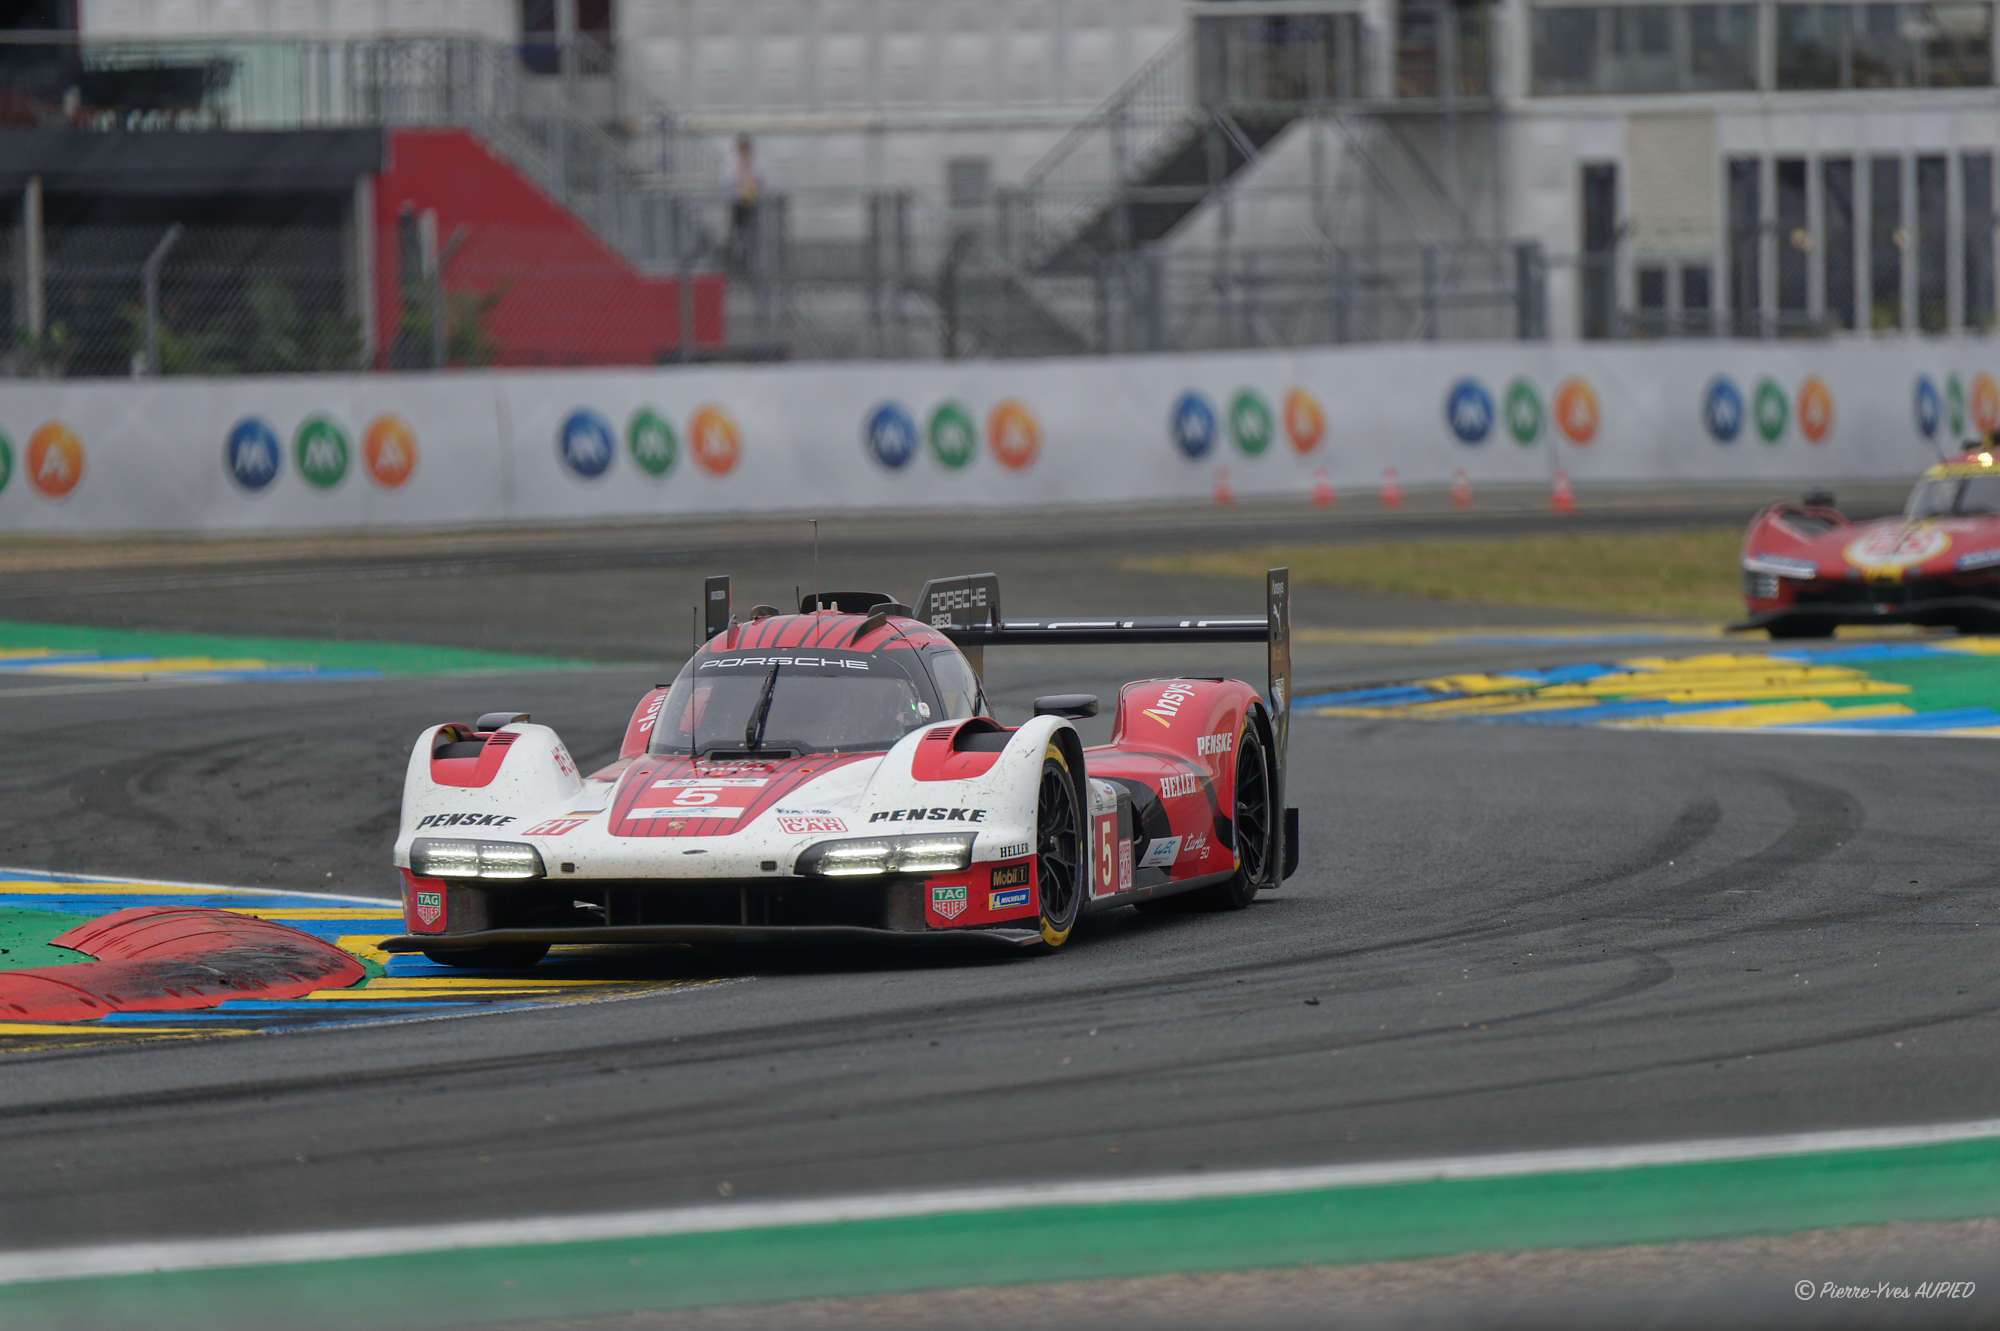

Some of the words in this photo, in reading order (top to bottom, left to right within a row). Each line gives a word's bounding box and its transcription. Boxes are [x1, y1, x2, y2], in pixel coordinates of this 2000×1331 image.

[931, 587, 986, 612] PORSCHE
[699, 656, 869, 670] PORSCHE
[1142, 683, 1195, 728] Ansys
[1197, 733, 1233, 756] PENSKE
[1160, 773, 1197, 798] HELLER
[672, 787, 723, 806] 5
[416, 813, 517, 830] PENSKE
[869, 808, 986, 823] PENSKE
[786, 822, 842, 831] CAR
[1000, 842, 1029, 858] HELLER
[1102, 821, 1112, 886] 5
[993, 868, 1017, 887] Mobil
[419, 895, 439, 905] TAG
[936, 889, 964, 899] TAG
[418, 906, 440, 922] HEUER
[934, 901, 967, 918] HEUER
